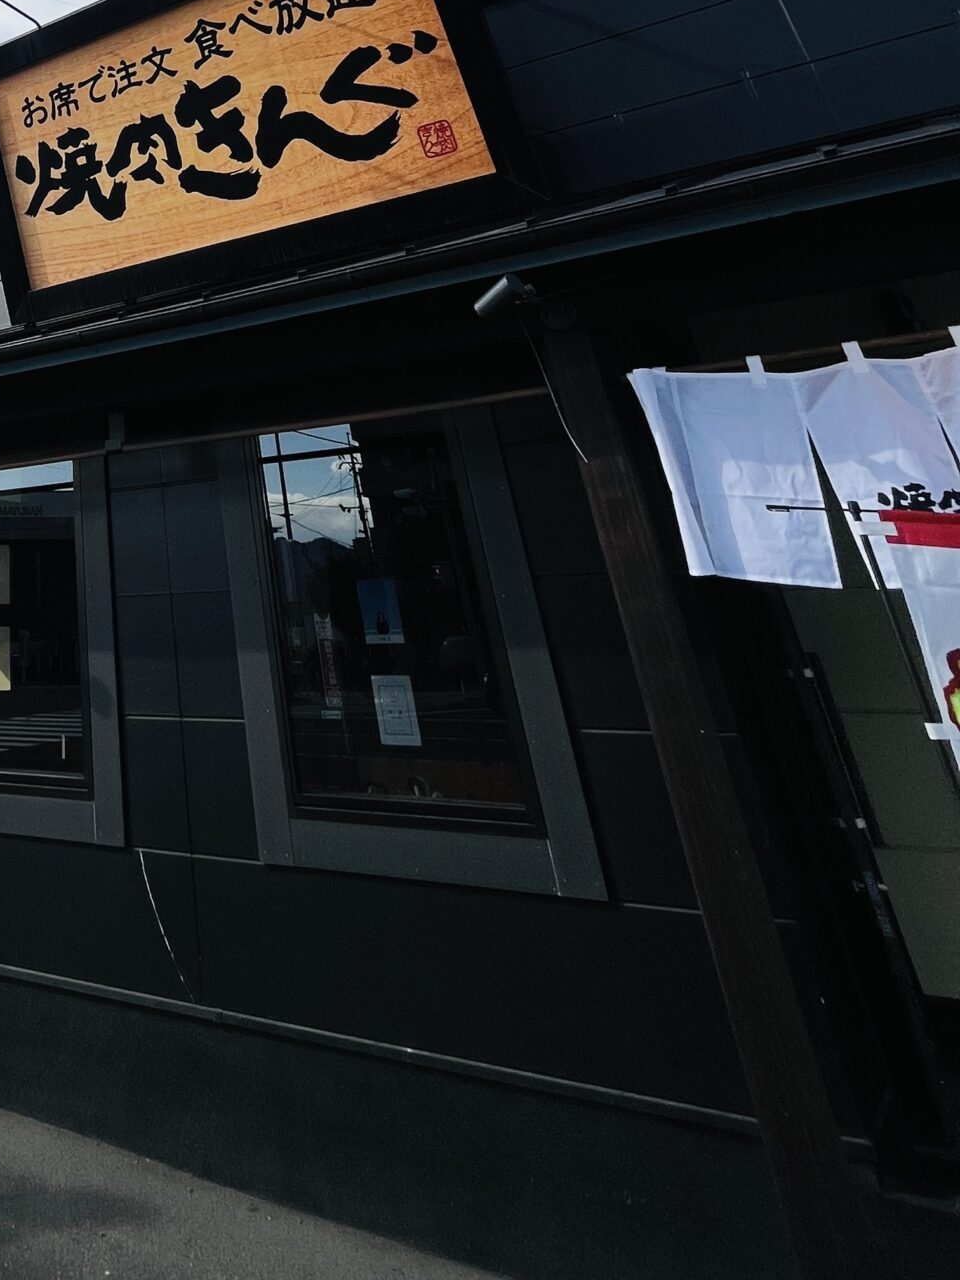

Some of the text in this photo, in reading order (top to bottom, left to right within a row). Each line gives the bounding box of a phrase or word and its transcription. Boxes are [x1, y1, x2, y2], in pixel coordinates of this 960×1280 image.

[15, 30, 438, 221] 焼肉きんぐ
[20, 46, 179, 128] お席で注文
